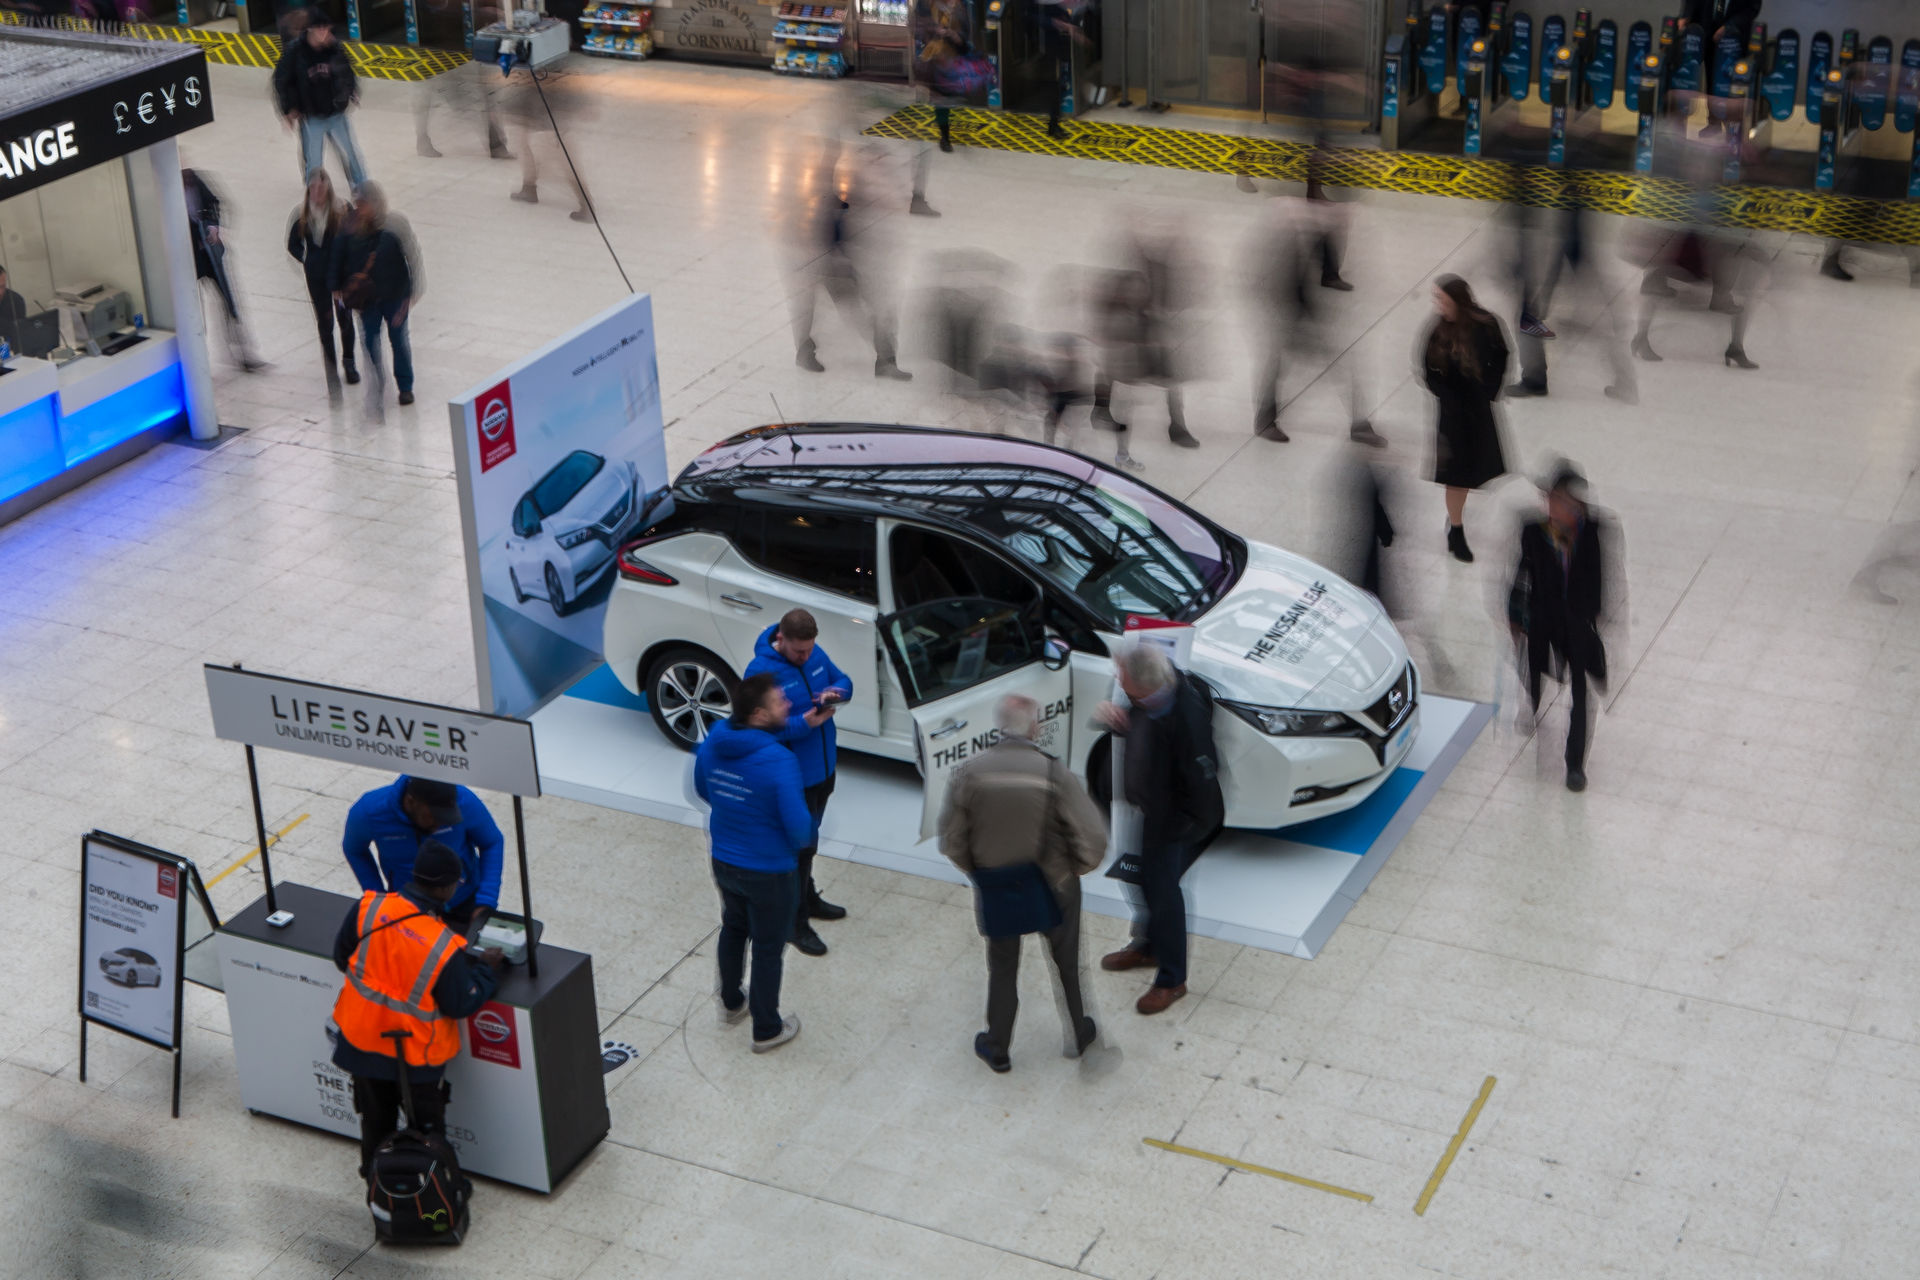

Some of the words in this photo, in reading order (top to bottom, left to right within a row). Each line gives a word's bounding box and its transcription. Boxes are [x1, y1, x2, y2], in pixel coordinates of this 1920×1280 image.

[711, 15, 725, 28] in
[677, 33, 761, 53] CORNWALL
[1244, 639, 1275, 664] THE
[1264, 603, 1309, 643] NISSAN
[1298, 581, 1328, 607] LEAF
[275, 723, 353, 749] UNLIMITED
[355, 738, 410, 760] PHONE
[412, 748, 470, 771] POWER
[933, 741, 967, 768] THE
[314, 1073, 343, 1091] THE
[317, 1088, 345, 1107] THE
